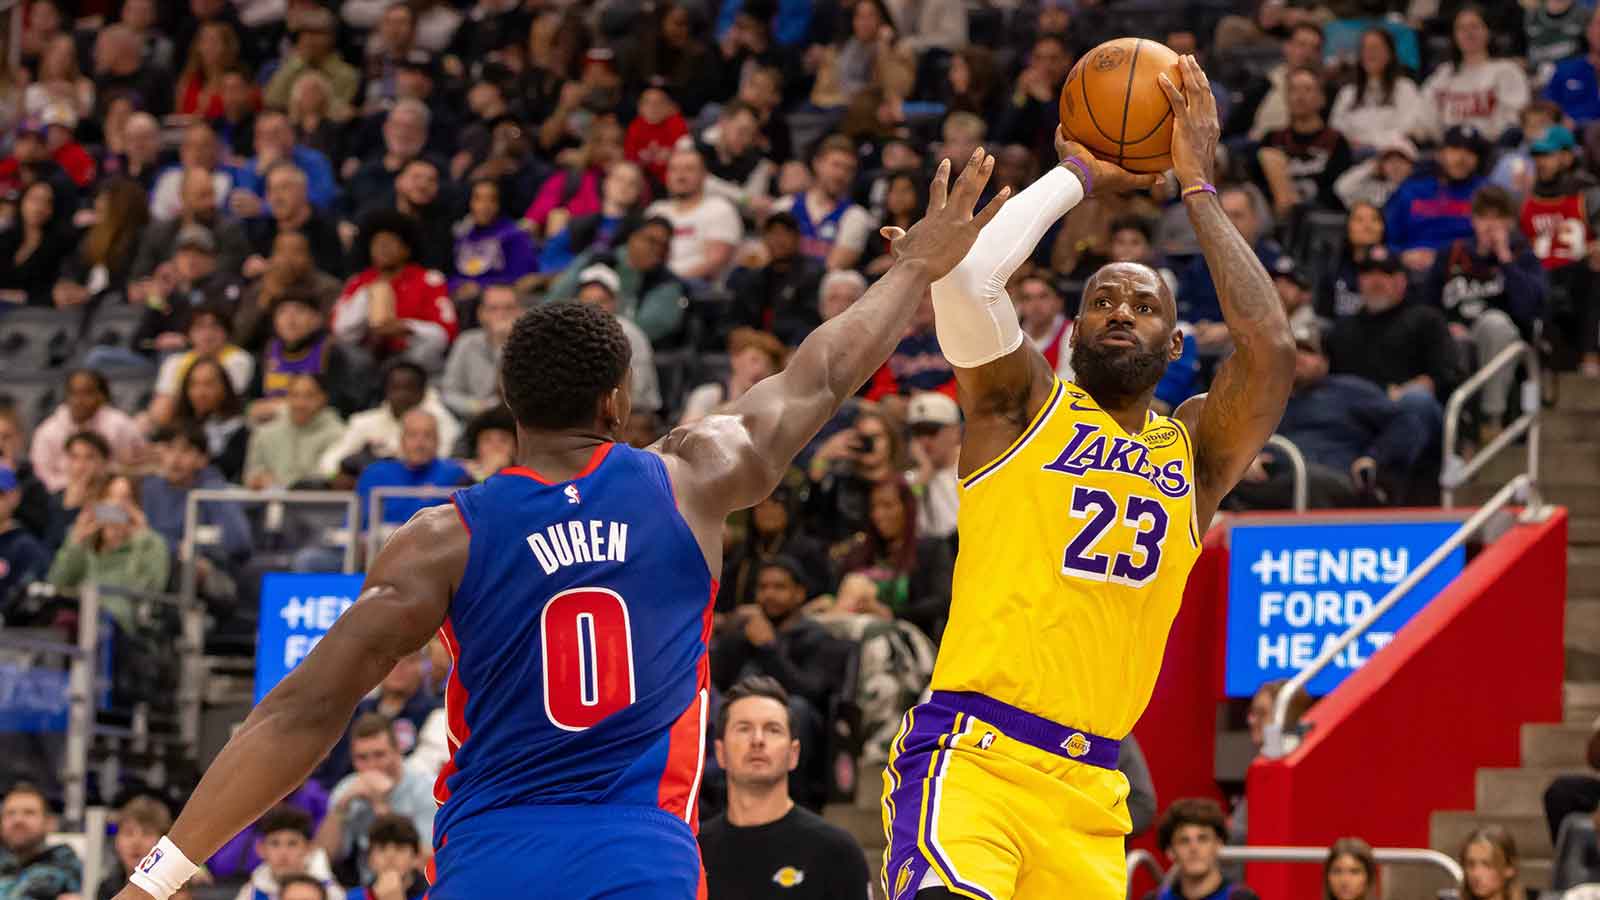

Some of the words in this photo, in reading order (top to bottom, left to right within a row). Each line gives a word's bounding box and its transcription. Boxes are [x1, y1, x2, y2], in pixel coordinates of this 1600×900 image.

[1043, 423, 1191, 498] LAKERS
[526, 520, 628, 575] DUREN
[1061, 486, 1169, 589] 23
[1251, 547, 1408, 584] HENRY
[1259, 590, 1374, 627] FORD
[540, 587, 636, 732] 0
